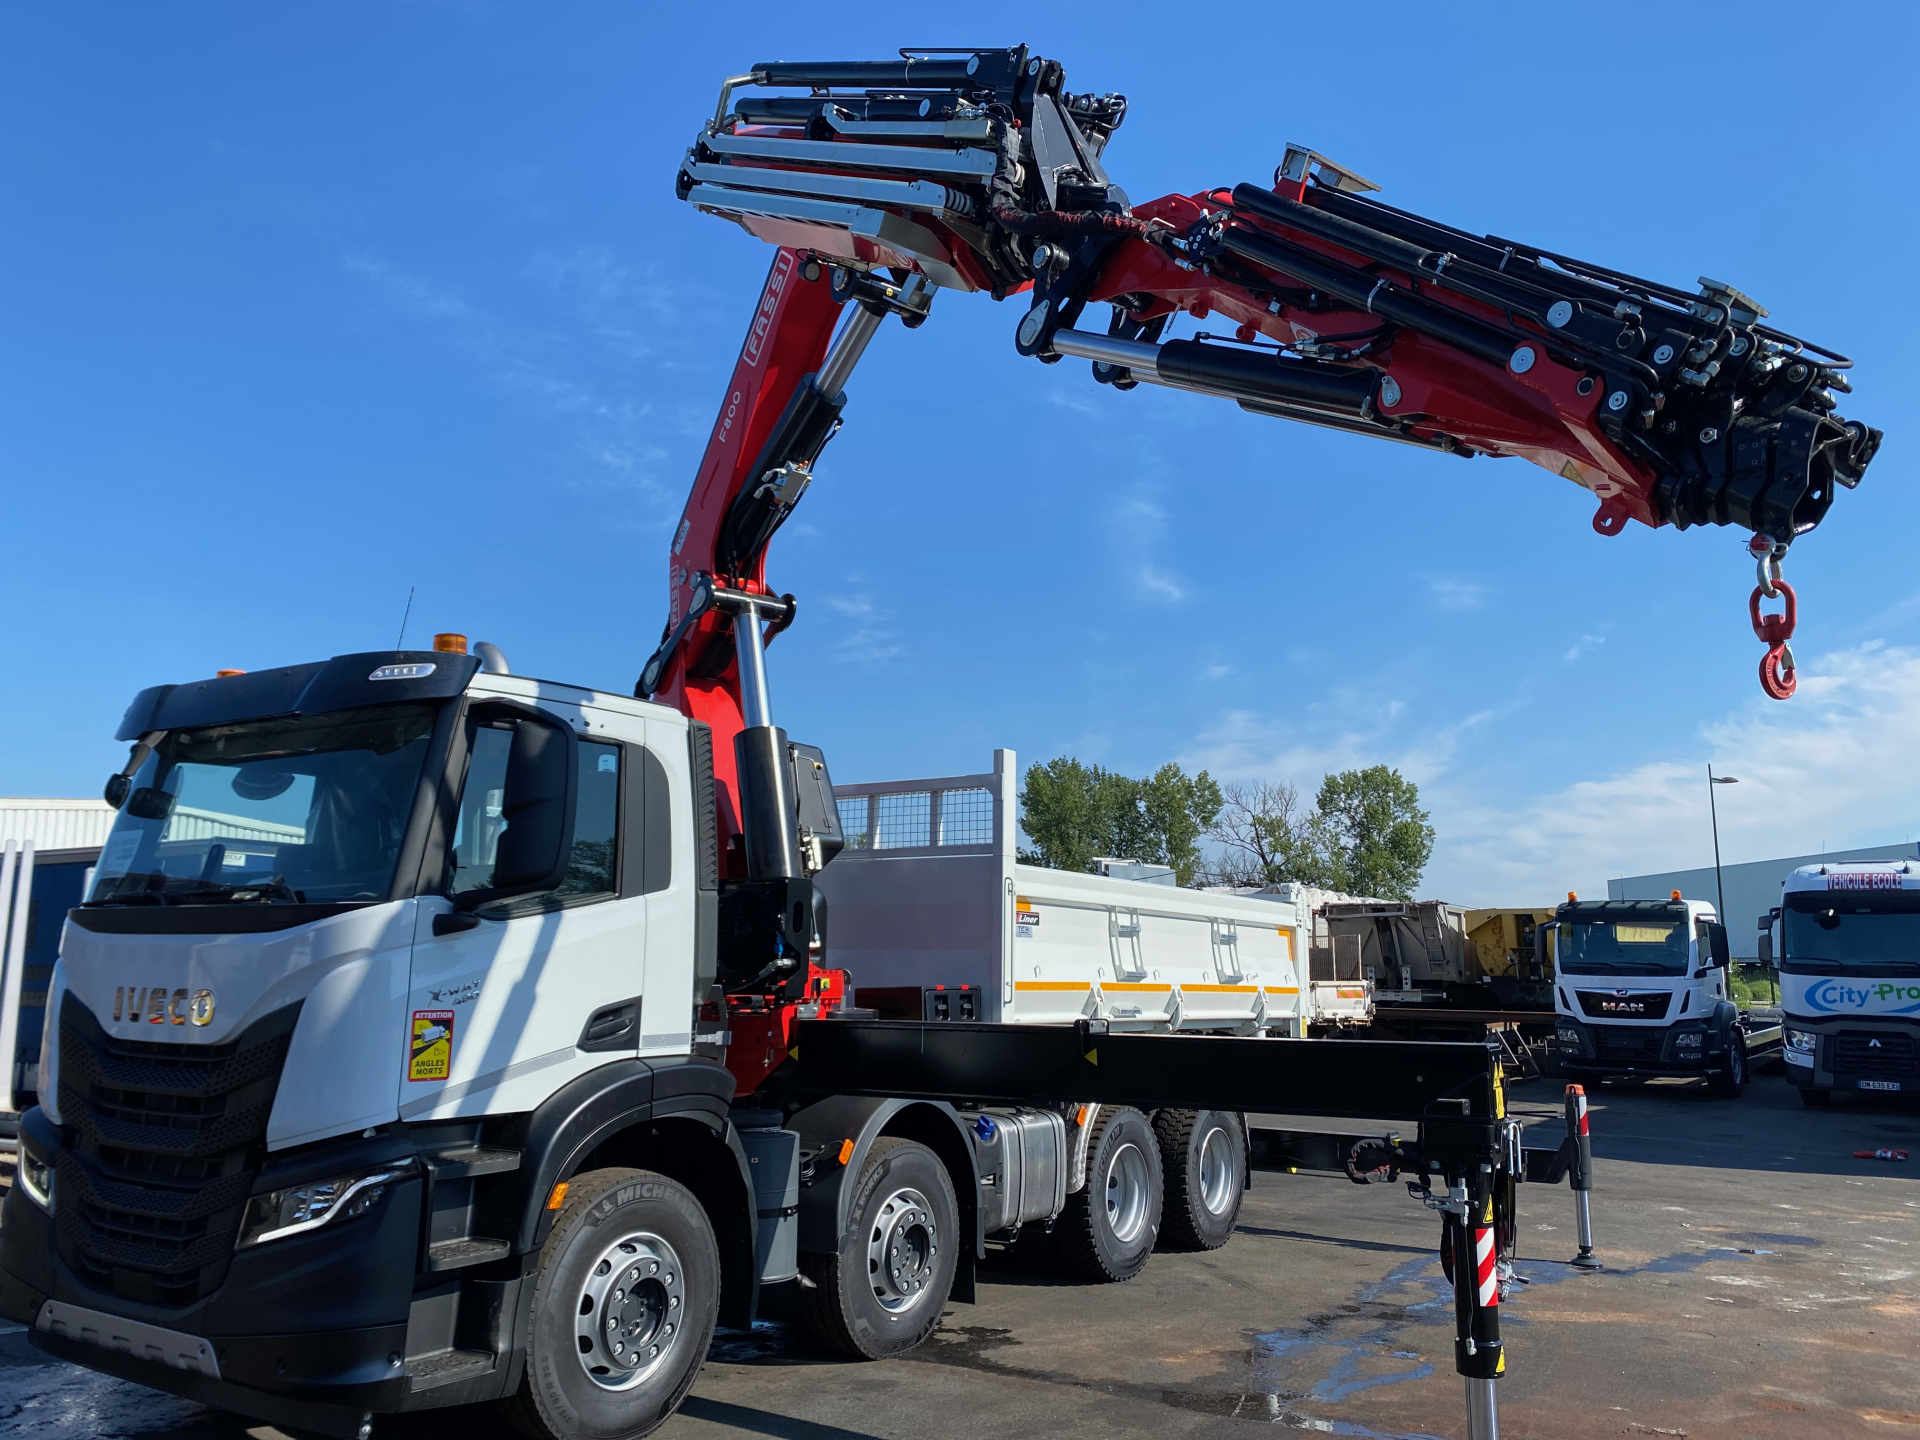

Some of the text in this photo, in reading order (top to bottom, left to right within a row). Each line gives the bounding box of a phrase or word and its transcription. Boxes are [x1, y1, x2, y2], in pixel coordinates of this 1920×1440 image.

[748, 258, 789, 357] FASSI
[718, 390, 741, 444] F800
[1018, 914, 1038, 924] Liner
[112, 986, 215, 1028] IVECO
[427, 978, 481, 1009] X-WAY
[1602, 1001, 1645, 1012] MAN
[415, 1059, 444, 1068] ANGLES
[415, 1067, 443, 1075] MORTS
[857, 1164, 884, 1207] WORKS
[616, 1183, 699, 1225] MICHELIN
